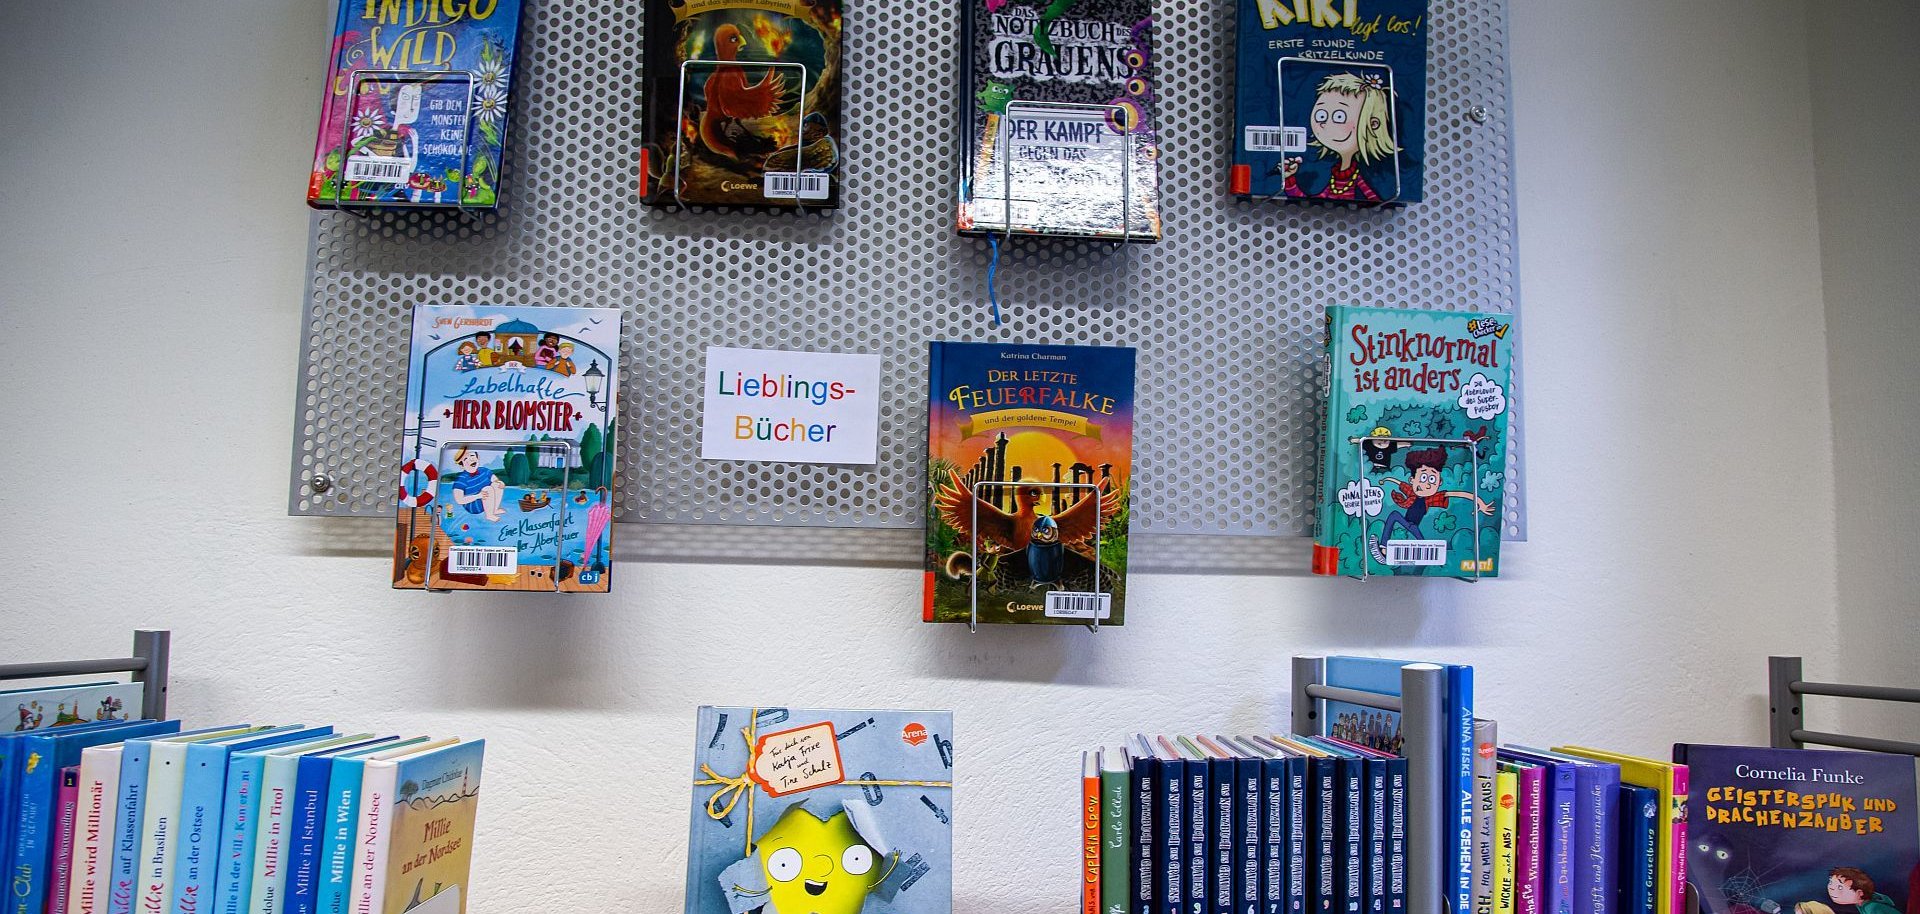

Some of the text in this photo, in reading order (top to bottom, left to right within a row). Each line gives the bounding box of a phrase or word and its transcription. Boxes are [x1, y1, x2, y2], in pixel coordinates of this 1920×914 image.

[1015, 8, 1035, 18] DAS
[1116, 27, 1133, 37] DES
[1268, 38, 1355, 49] ERSTE STUNDE
[369, 27, 458, 71] WILD
[994, 40, 1135, 80] GRAUENS
[1298, 50, 1385, 61] KRITZELKUNDE
[430, 99, 463, 111] GIB DEM
[440, 129, 464, 141] KEINE
[1044, 120, 1105, 144] KAMPF
[1000, 352, 1067, 361] Katrina Charman
[1350, 324, 1498, 368] Stinknormal
[719, 371, 856, 405] Lieblings-
[988, 370, 1078, 385] DER LETZTE
[1355, 366, 1380, 392] ist
[1384, 364, 1461, 394] anders
[949, 384, 1115, 415] FEUERFALKE
[452, 400, 573, 432] HERR BLOMSTER
[735, 415, 837, 442] Bücher
[984, 414, 1077, 427] und der goldene Tempel
[498, 524, 518, 541] Eine
[901, 729, 928, 739] Arena
[772, 755, 797, 772] Katja
[802, 759, 831, 780] Schulz
[1735, 764, 1864, 785] Cornelia Funke
[1459, 706, 1473, 910] ANNA FISKE ALLE GEHEN IN DIE
[1478, 775, 1493, 811] RAUS!
[1706, 786, 1897, 812] GEISTERSPUK UND
[87, 780, 104, 842] Millionär
[302, 790, 318, 840] Istanbul
[1108, 785, 1123, 848] Carlo Collodi
[1706, 805, 1884, 835] DRACHENZAUBER
[120, 784, 139, 875] auf Klassenfahrt
[188, 805, 204, 880] an der Ostsee
[229, 769, 250, 892] in der Villa Kunterbunt
[264, 787, 284, 877] Millie in Tirol
[331, 790, 352, 883] Millie in Wien
[363, 792, 381, 889] an der Nordsee
[423, 817, 451, 843] Millie
[1503, 827, 1512, 849] AUS!
[1528, 779, 1540, 881] Wunschbuchladen
[85, 847, 98, 870] wird
[152, 816, 168, 879] in Brasilien
[301, 844, 313, 856] in
[402, 837, 462, 875] an der Nordsee
[1085, 834, 1100, 884] CAPTAIN
[1480, 841, 1491, 866] MICH
[296, 859, 311, 895] Millie
[1481, 869, 1491, 887] HOL
[1645, 828, 1655, 909] der Gruselburg
[1500, 877, 1512, 909] WICKLE
